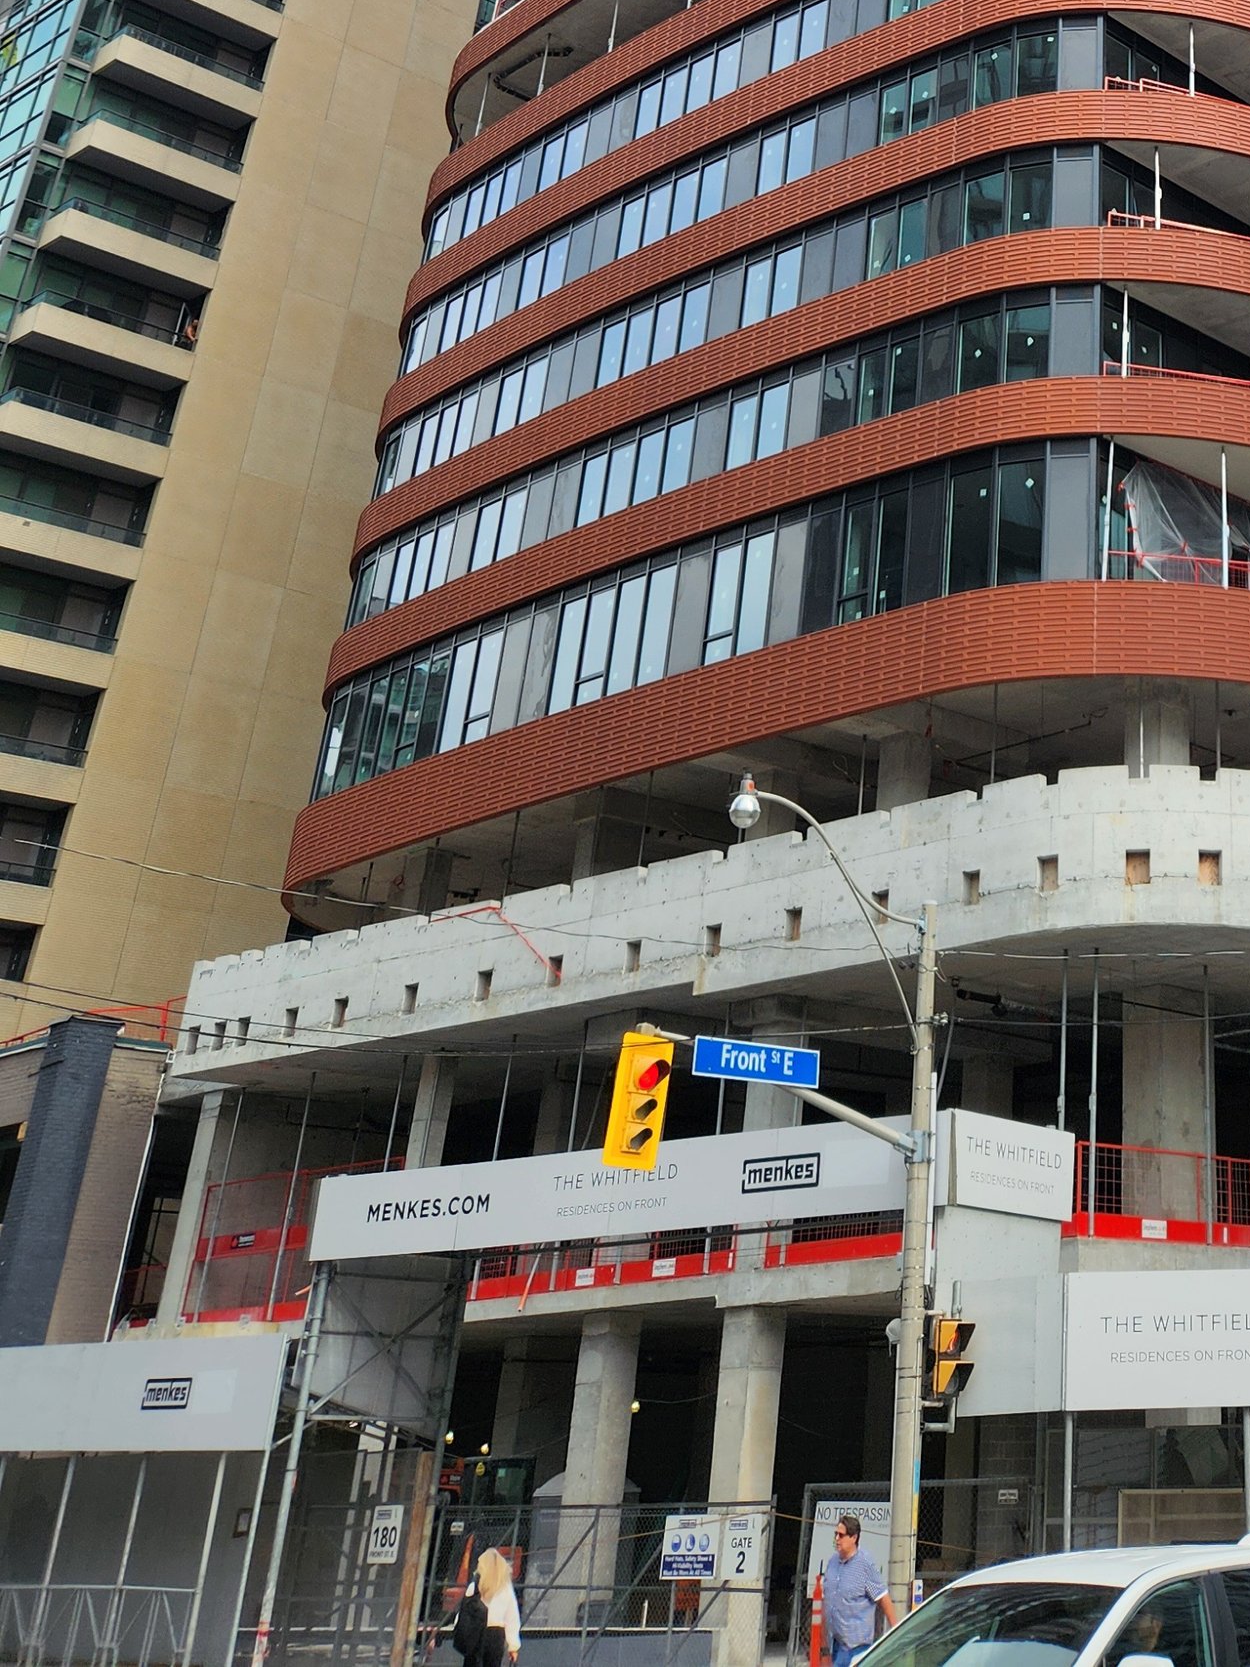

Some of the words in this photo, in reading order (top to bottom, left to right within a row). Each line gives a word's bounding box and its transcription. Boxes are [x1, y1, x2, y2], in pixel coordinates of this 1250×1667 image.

[721, 1044, 767, 1073] Front
[771, 1050, 781, 1064] St
[783, 1052, 794, 1076] E
[967, 1136, 991, 1156] THE
[996, 1142, 1062, 1169] WHITFIELD
[553, 1174, 584, 1191] THE
[591, 1163, 678, 1187] WHITFIELD
[746, 1155, 815, 1185] menkes
[970, 1171, 1016, 1189] RESIDENCES
[1018, 1180, 1029, 1191] ON
[1030, 1182, 1055, 1194] FRONT
[366, 1193, 491, 1223] MENKES.COM
[557, 1202, 615, 1217] RESIDENCES
[617, 1201, 632, 1211] ON
[634, 1197, 668, 1209] FRONT
[1100, 1316, 1143, 1334] THE
[1110, 1350, 1190, 1363] RESIDENCES
[1194, 1349, 1213, 1362] ON
[145, 1380, 189, 1403] menkes
[817, 1507, 831, 1520] NO
[834, 1507, 891, 1521] TRESPASSIN
[373, 1526, 397, 1548] 180
[731, 1537, 752, 1548] GATE
[735, 1551, 746, 1574] 2
